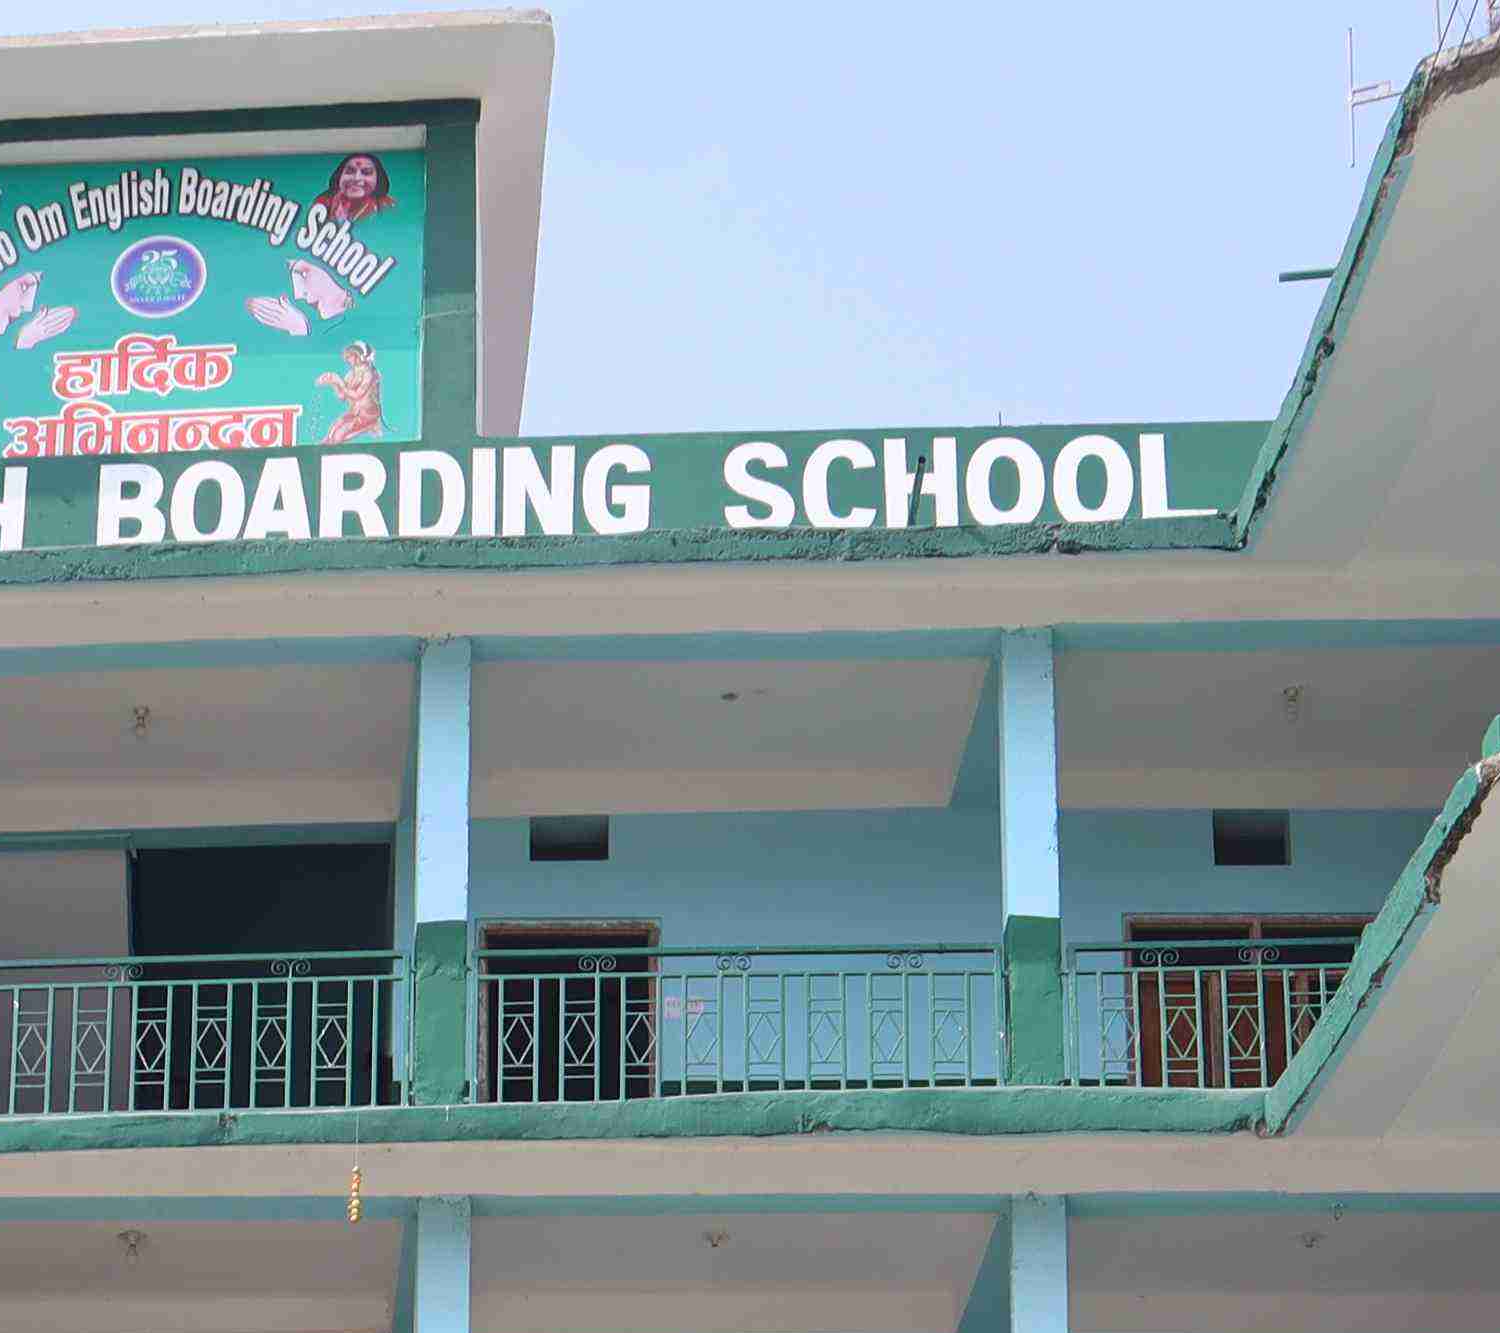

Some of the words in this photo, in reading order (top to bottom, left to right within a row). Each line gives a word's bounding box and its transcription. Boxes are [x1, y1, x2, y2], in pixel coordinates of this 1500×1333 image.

[15, 201, 68, 251] Om
[69, 168, 170, 231] English
[179, 167, 299, 246] Boarding
[296, 203, 396, 295] School
[54, 333, 237, 398] हार्दिक
[3, 401, 302, 457] अभिनन्दन
[97, 444, 652, 546] BOARDING
[722, 433, 1219, 528] SCHOOL
